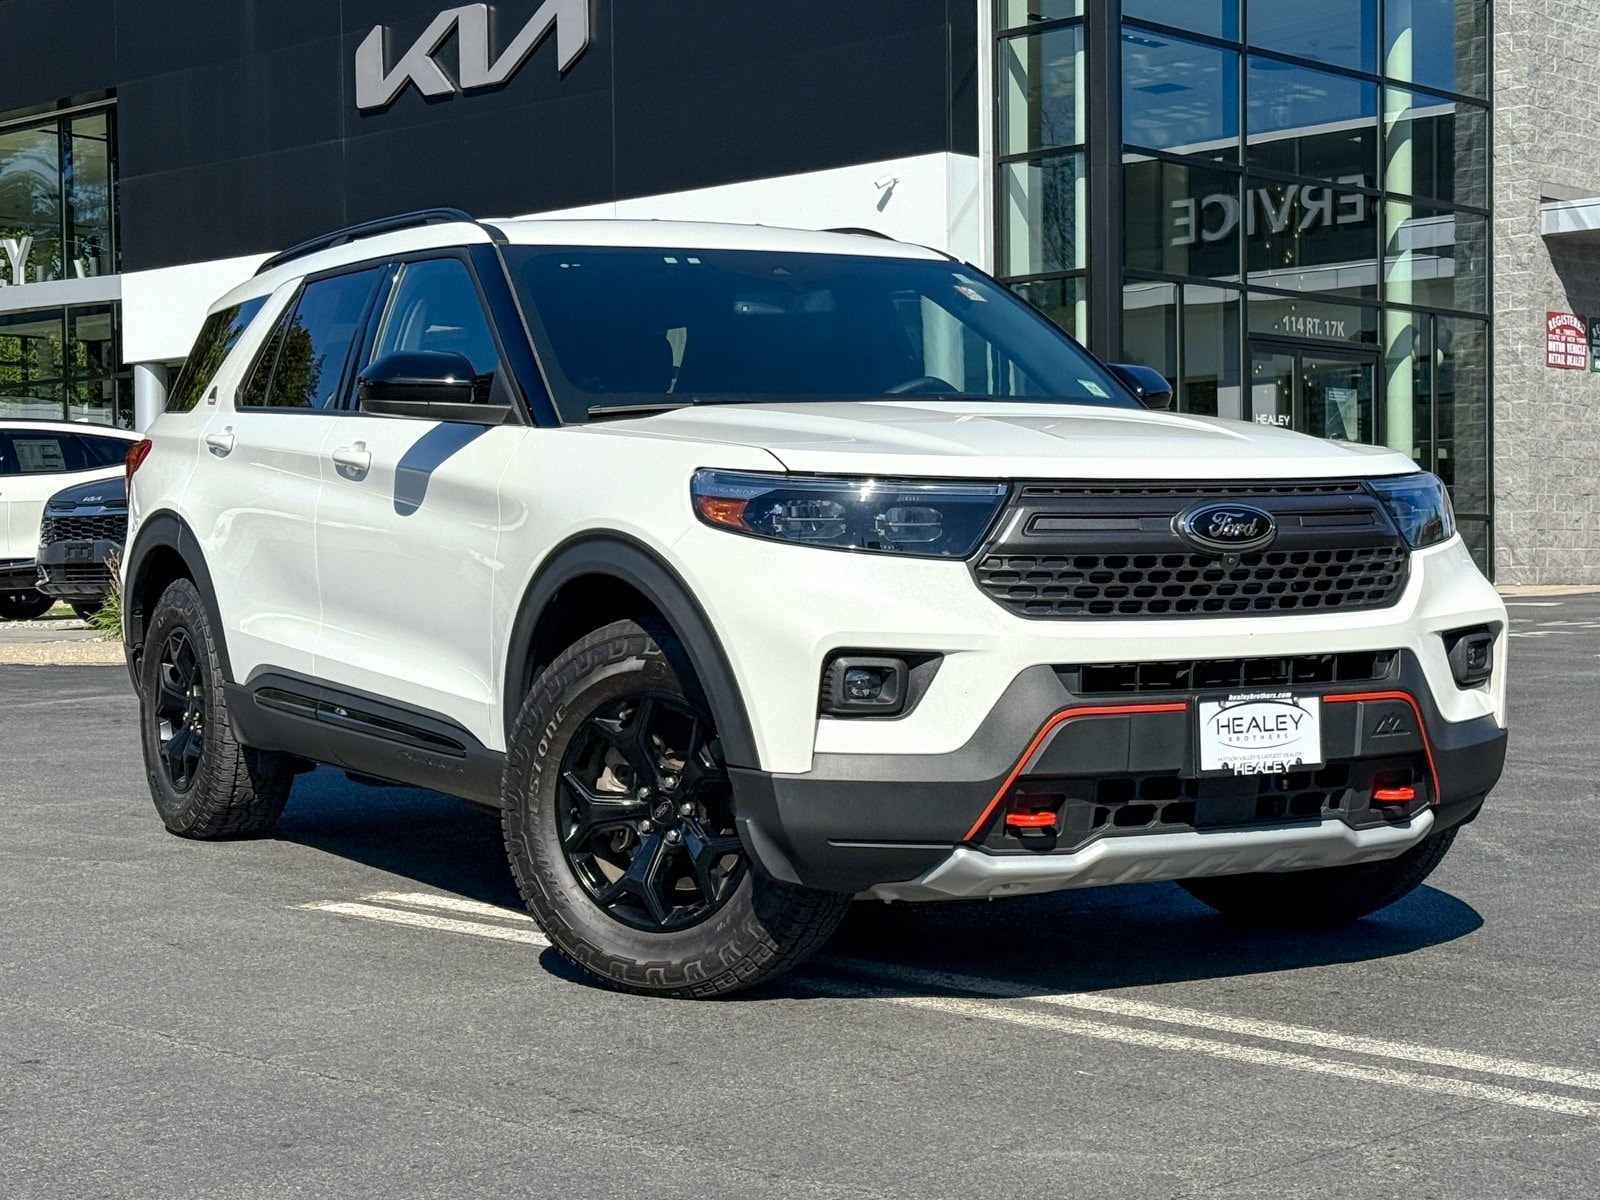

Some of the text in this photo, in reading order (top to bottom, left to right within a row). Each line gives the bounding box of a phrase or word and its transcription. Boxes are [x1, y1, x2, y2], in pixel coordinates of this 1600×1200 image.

[1283, 316, 1345, 337] 114 RT. 17K
[1548, 315, 1586, 334] REGISTERED
[1567, 344, 1587, 355] VEHICLE
[1548, 353, 1585, 367] RETAIL DEALER
[1256, 414, 1290, 426] HEALEY
[1209, 512, 1258, 537] Ford
[1228, 692, 1293, 701] healeybrothers.com
[1217, 713, 1304, 736] HEALEY
[1228, 732, 1289, 743] BROTHERS
[1233, 760, 1292, 777] HEALEY
